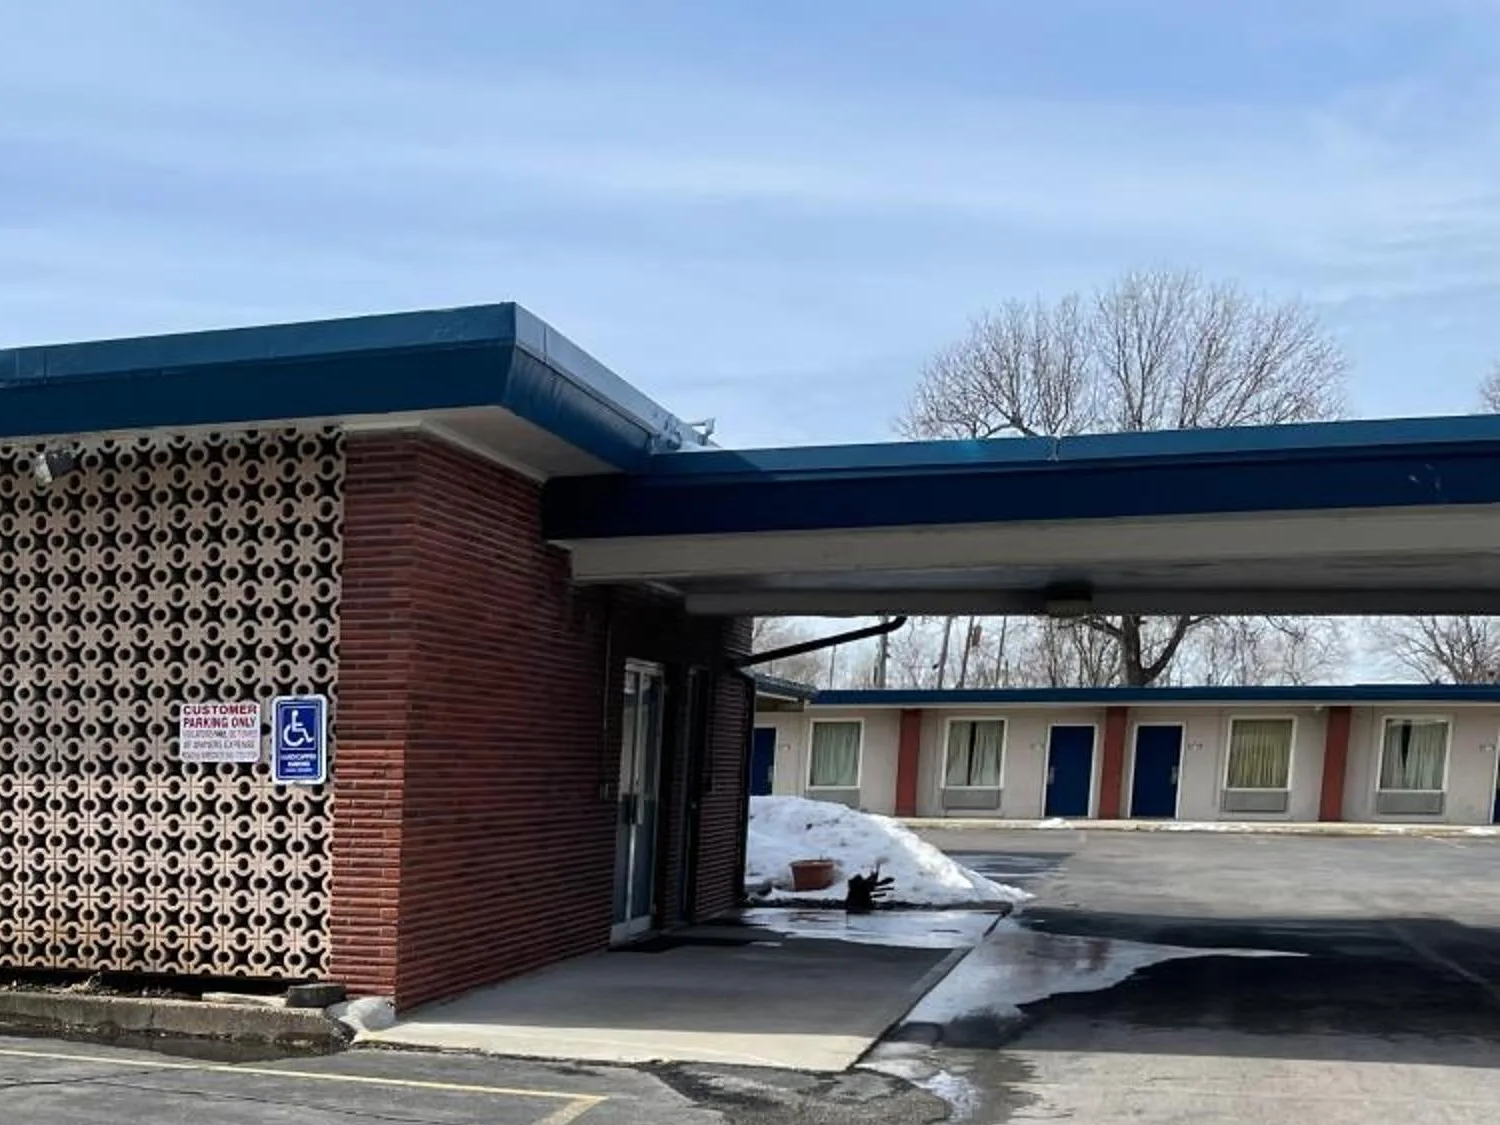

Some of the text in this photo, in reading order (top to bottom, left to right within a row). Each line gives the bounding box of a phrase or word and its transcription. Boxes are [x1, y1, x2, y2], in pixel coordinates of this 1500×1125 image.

[183, 704, 257, 715] CUSTOMER
[183, 717, 256, 729] PARKING ONLY
